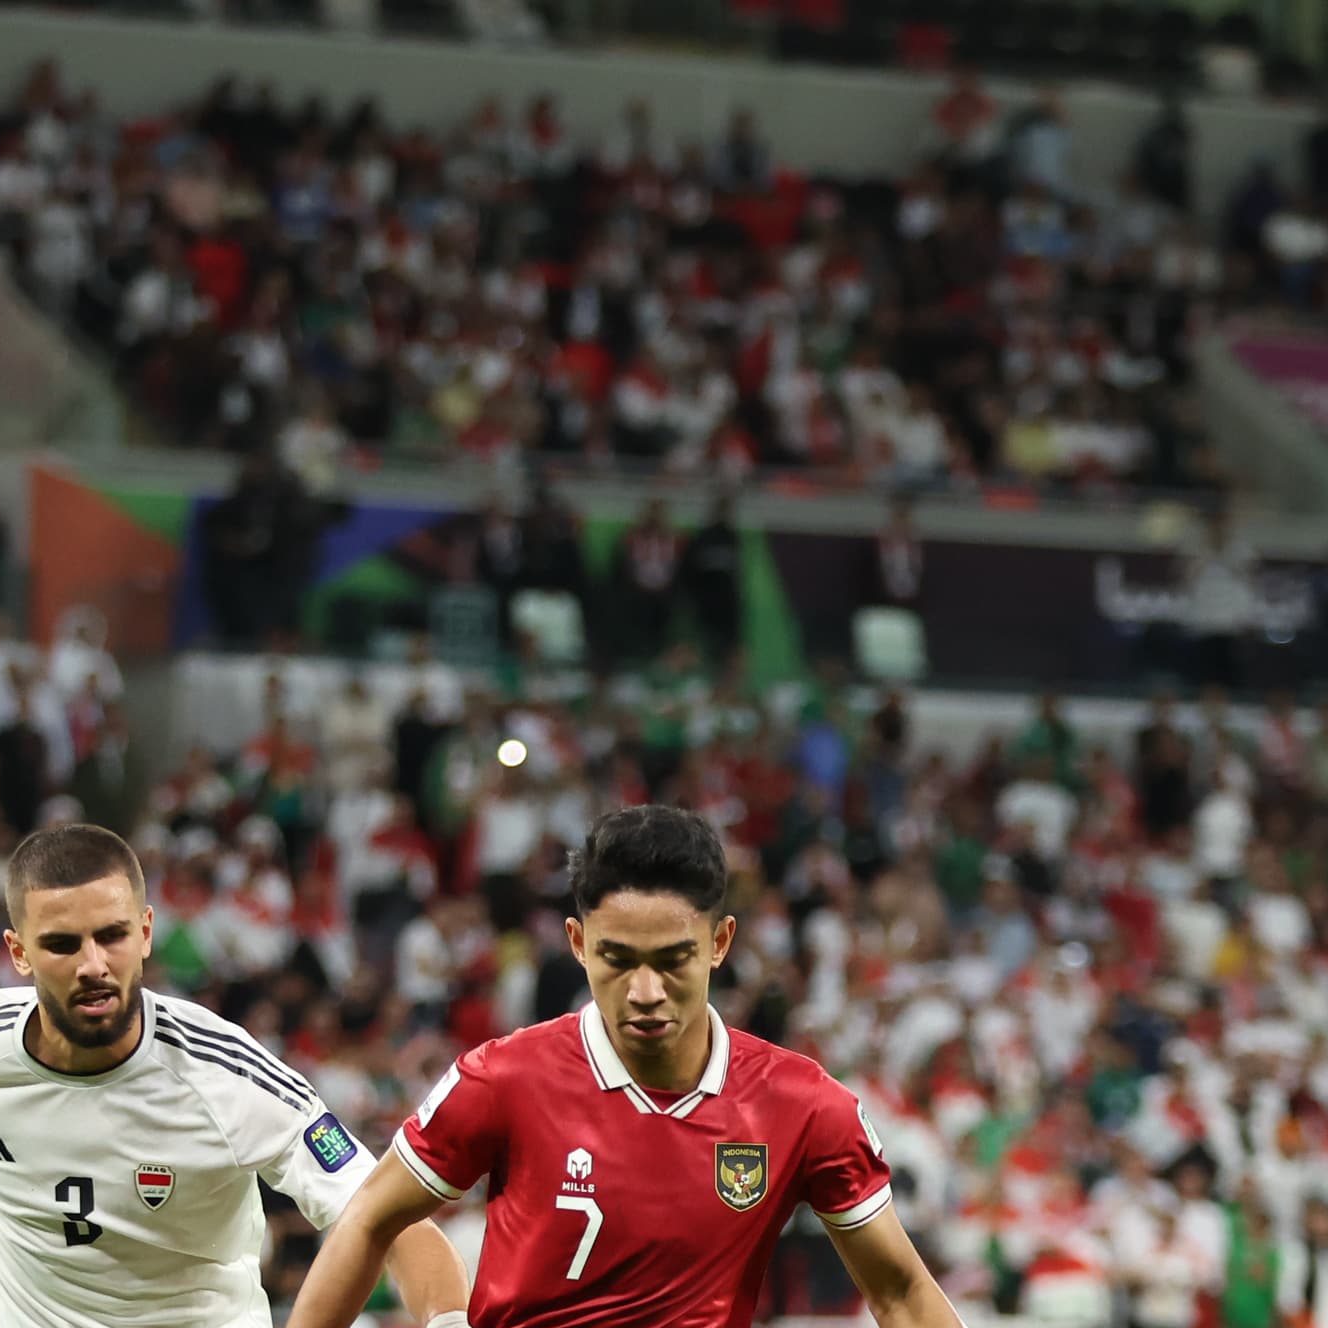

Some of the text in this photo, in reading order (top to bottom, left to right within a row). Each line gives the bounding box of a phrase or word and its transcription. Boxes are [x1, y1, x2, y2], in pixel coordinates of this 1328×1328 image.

[311, 1125, 328, 1142] AFC
[723, 1148, 760, 1157] INDONESIA
[562, 1181, 595, 1193] MILLS
[55, 1176, 103, 1246] 3
[555, 1195, 604, 1281] 7
